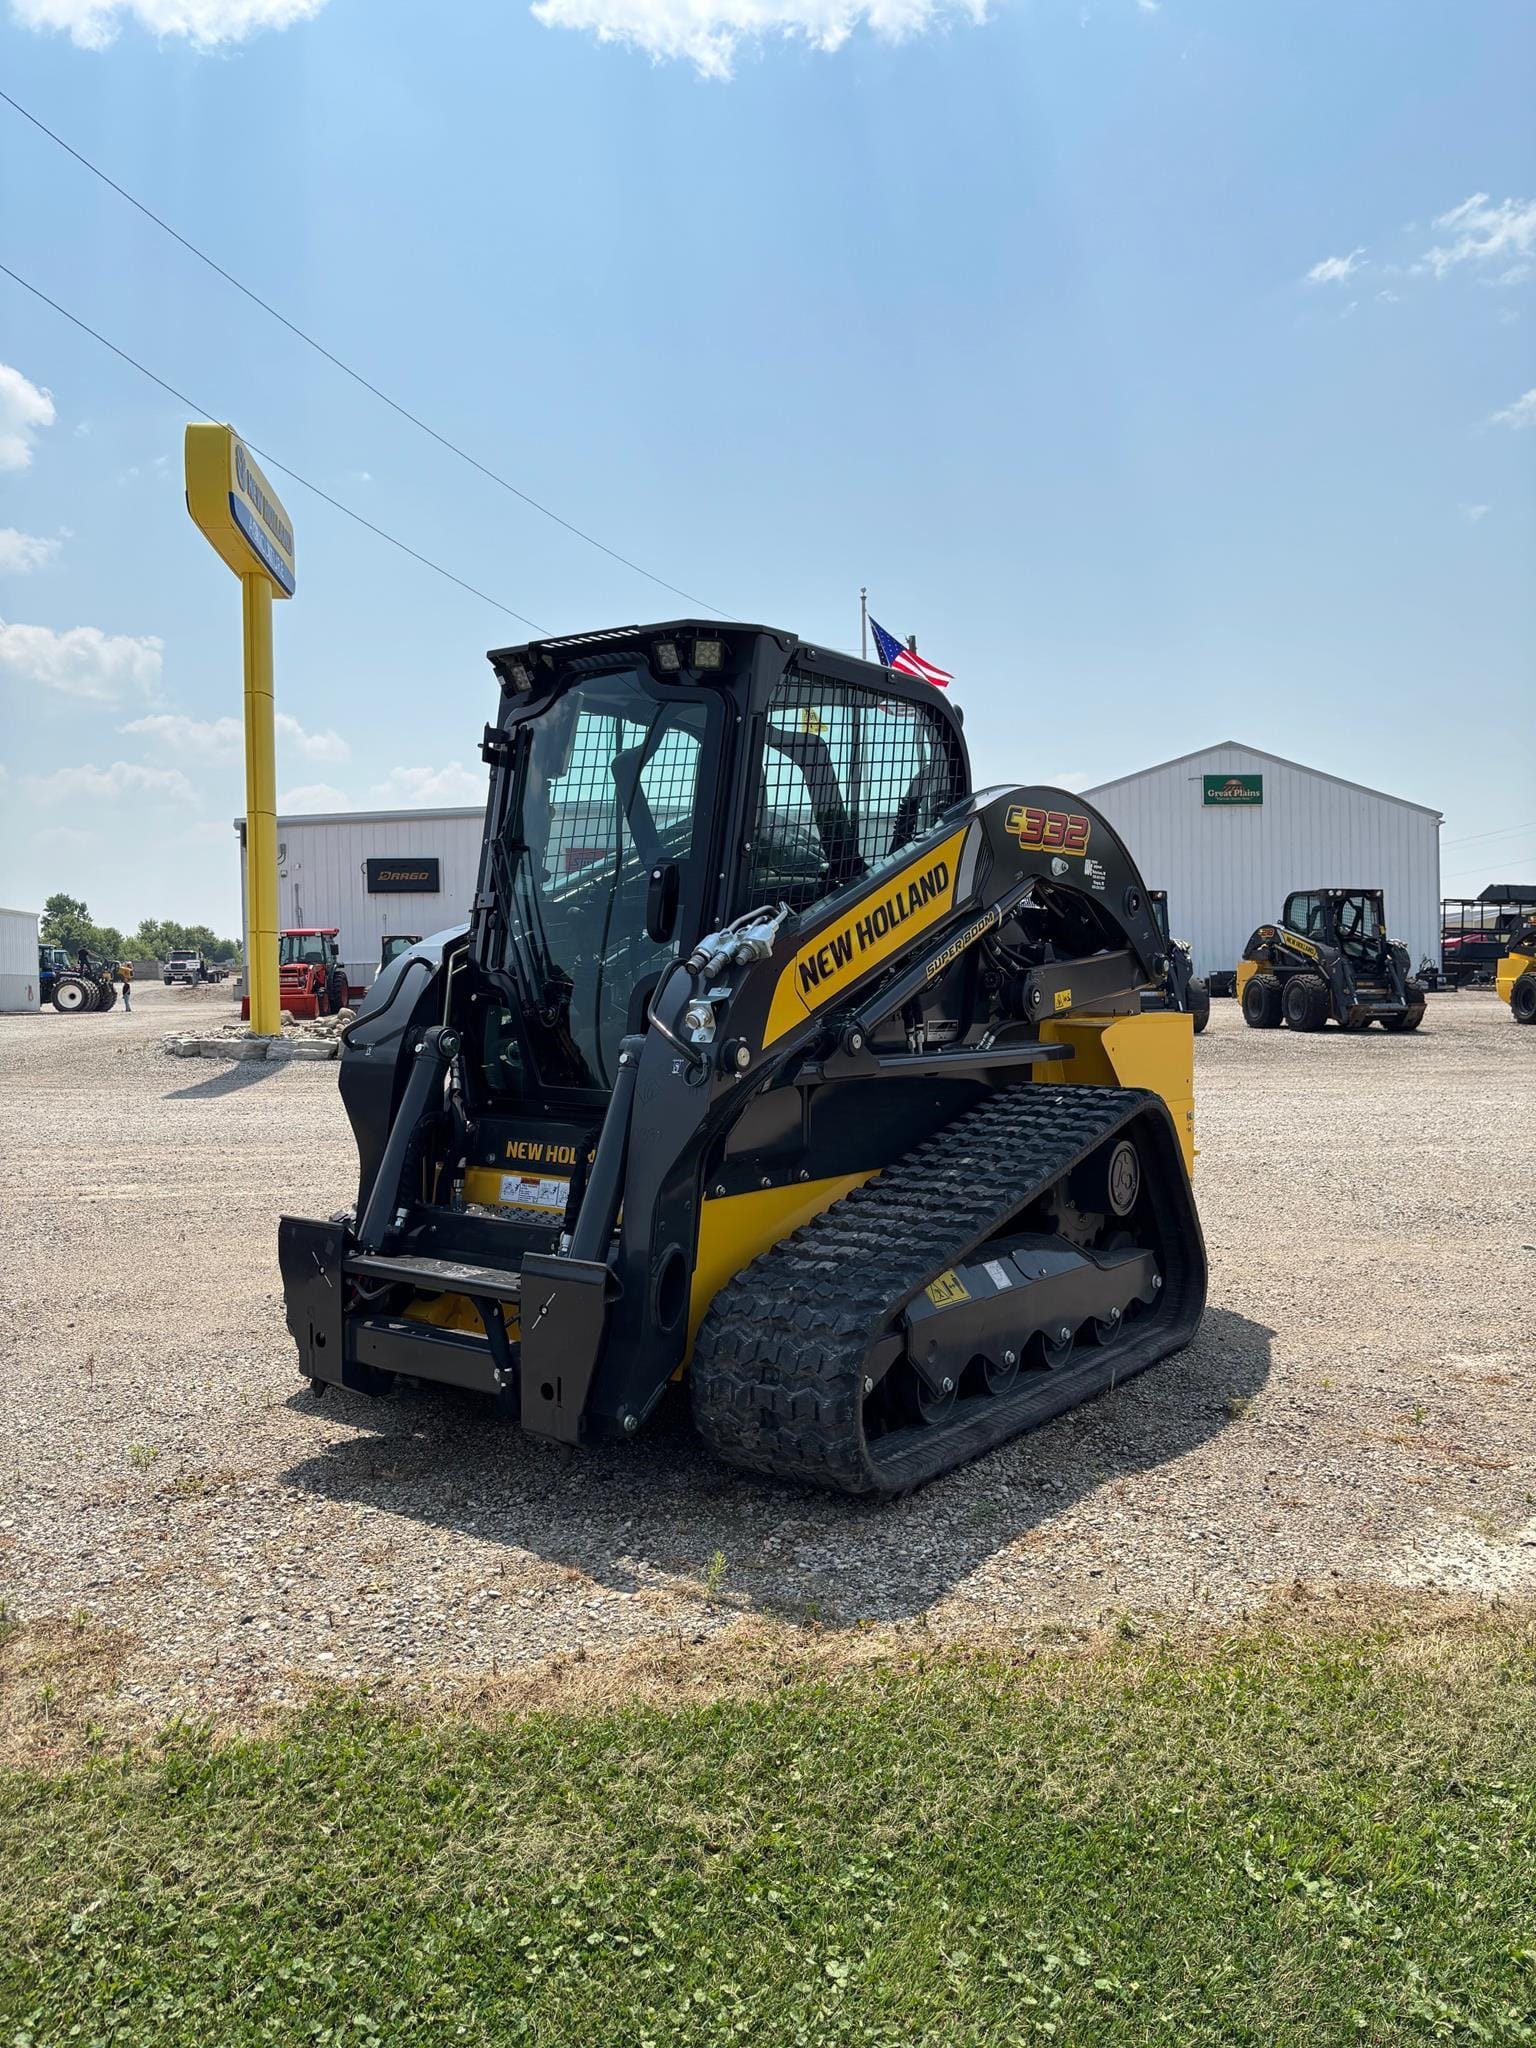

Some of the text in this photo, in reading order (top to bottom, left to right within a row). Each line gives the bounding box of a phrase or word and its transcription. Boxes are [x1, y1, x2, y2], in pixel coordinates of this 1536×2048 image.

[1207, 789, 1261, 797] Great Plains
[1005, 805, 1090, 856] C332
[799, 861, 949, 993] NEW HOLLAND
[927, 911, 994, 977] SUPER BOOM
[506, 1141, 544, 1161] NEW
